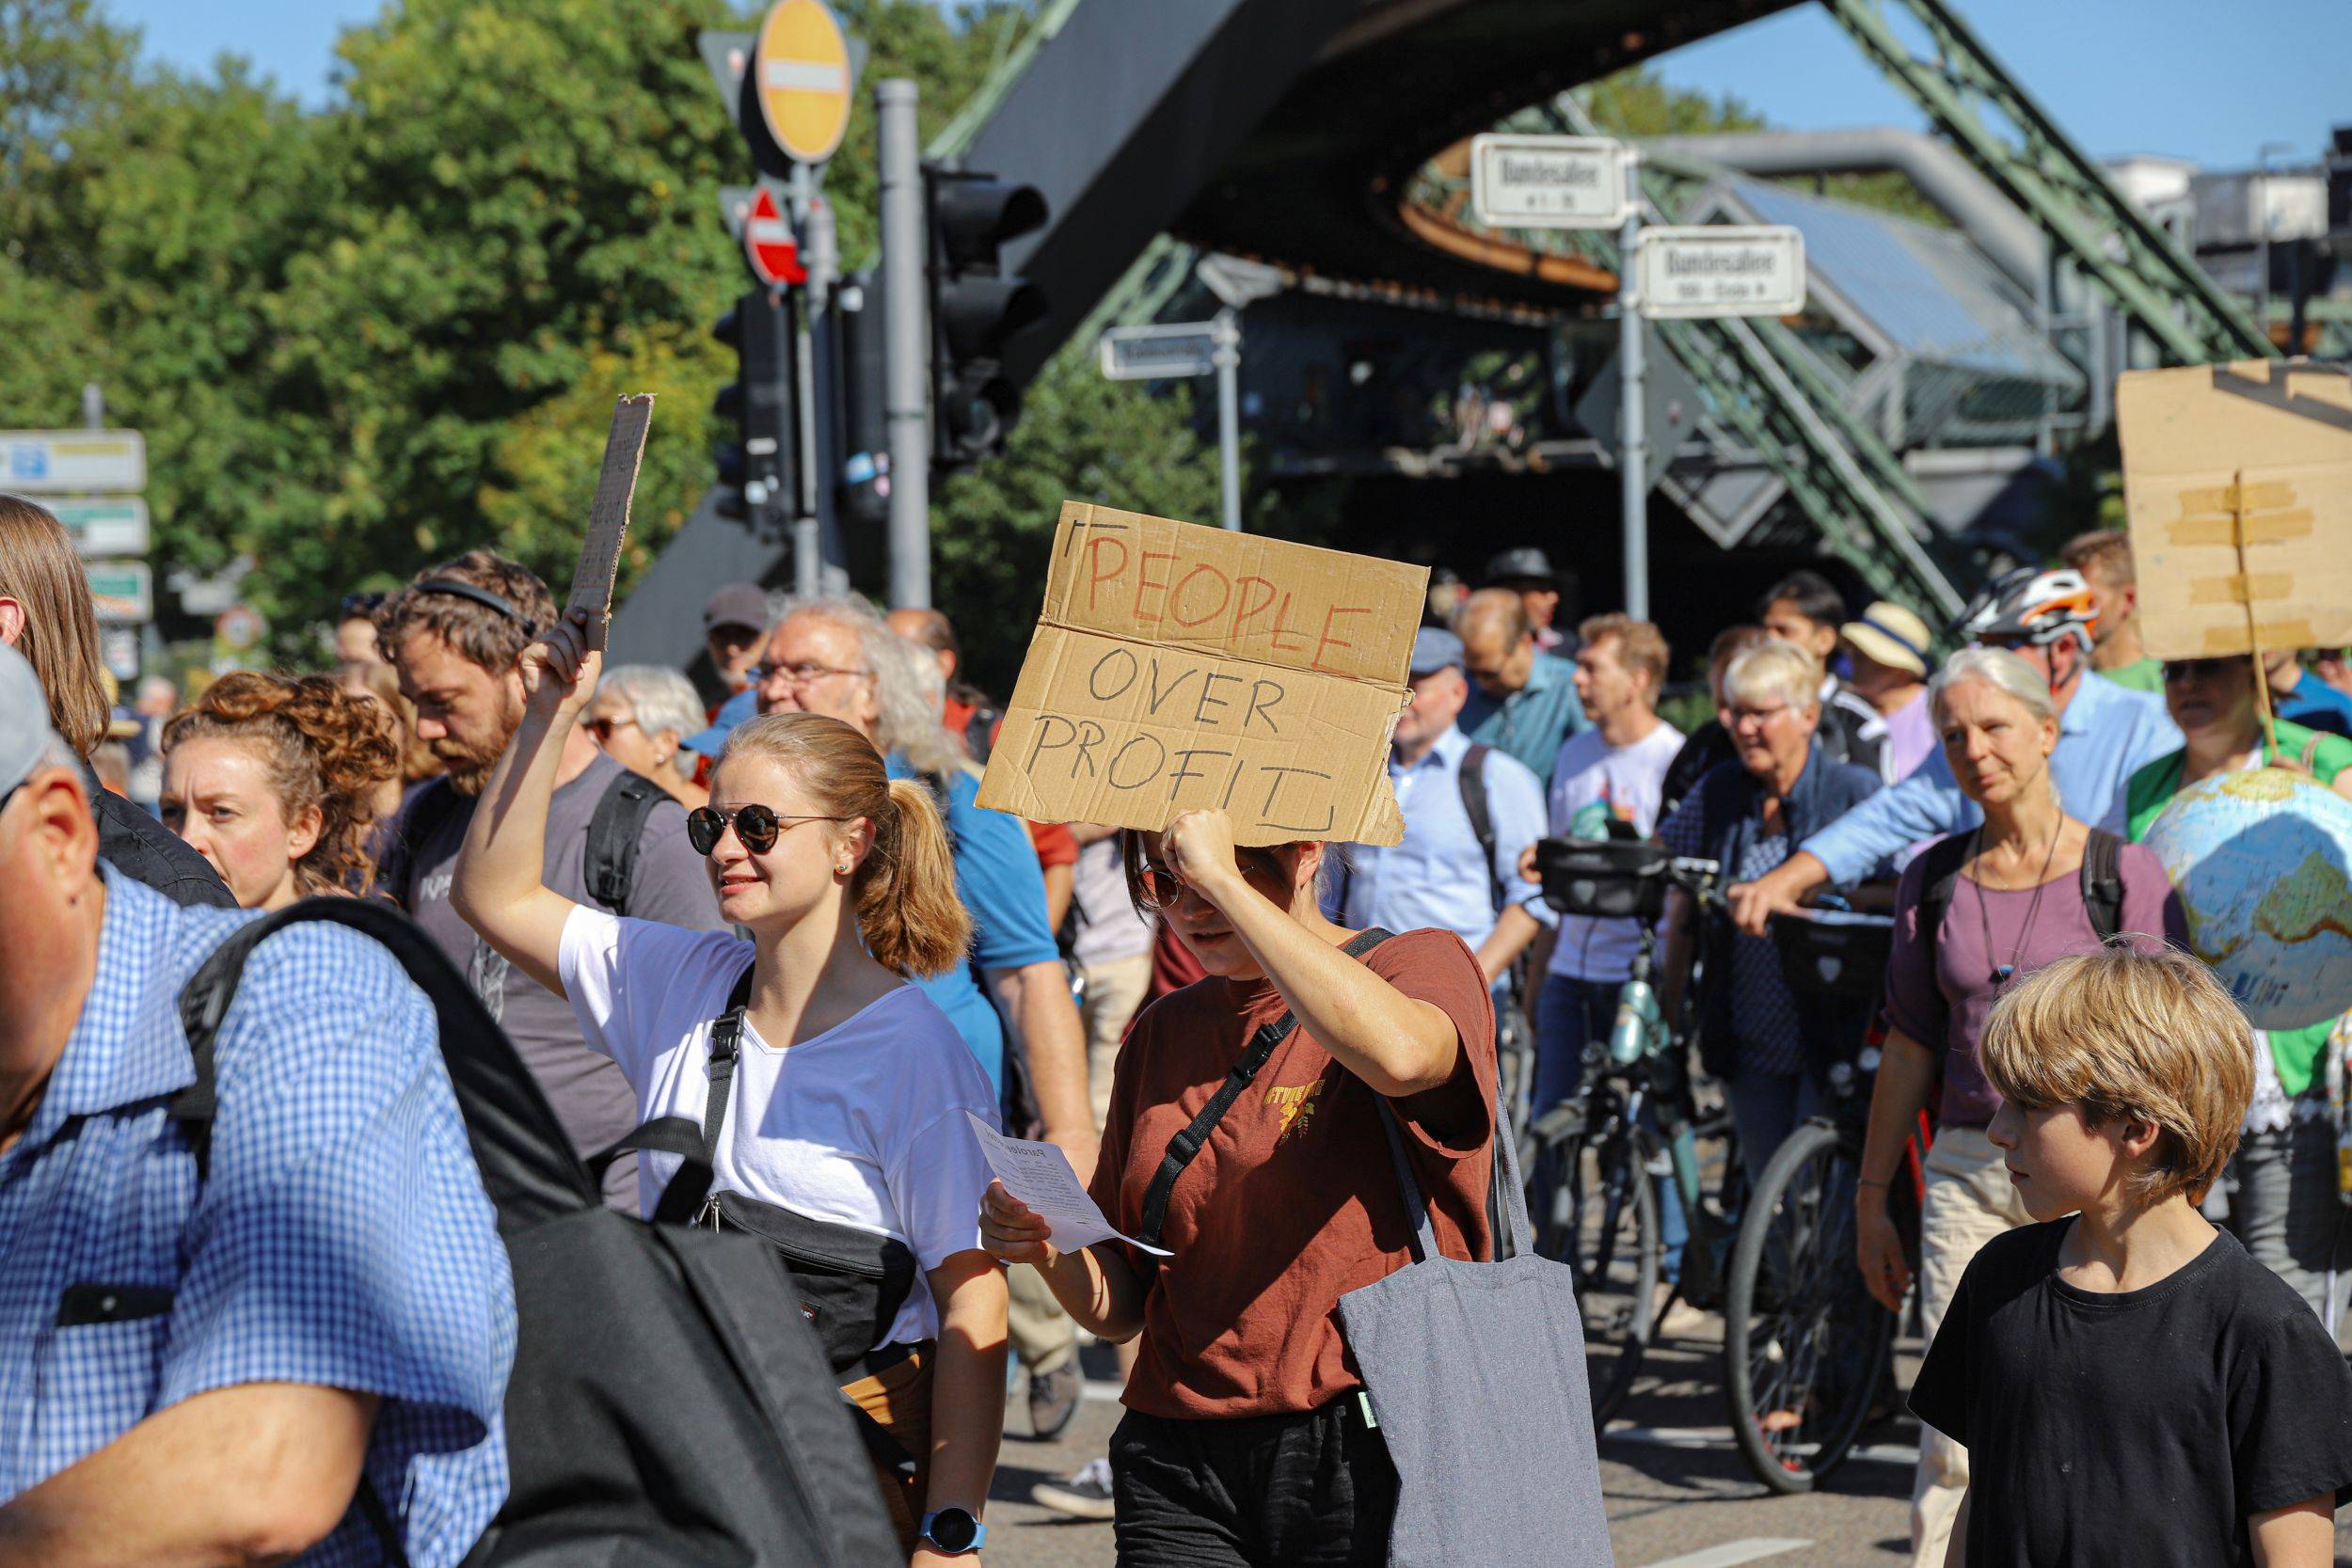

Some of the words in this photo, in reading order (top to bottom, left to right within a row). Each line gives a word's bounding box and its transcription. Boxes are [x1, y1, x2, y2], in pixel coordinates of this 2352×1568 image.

[1088, 536, 1373, 682] PEOPLE
[1089, 647, 1285, 734] OVER
[1026, 715, 1331, 817] PROFIT
